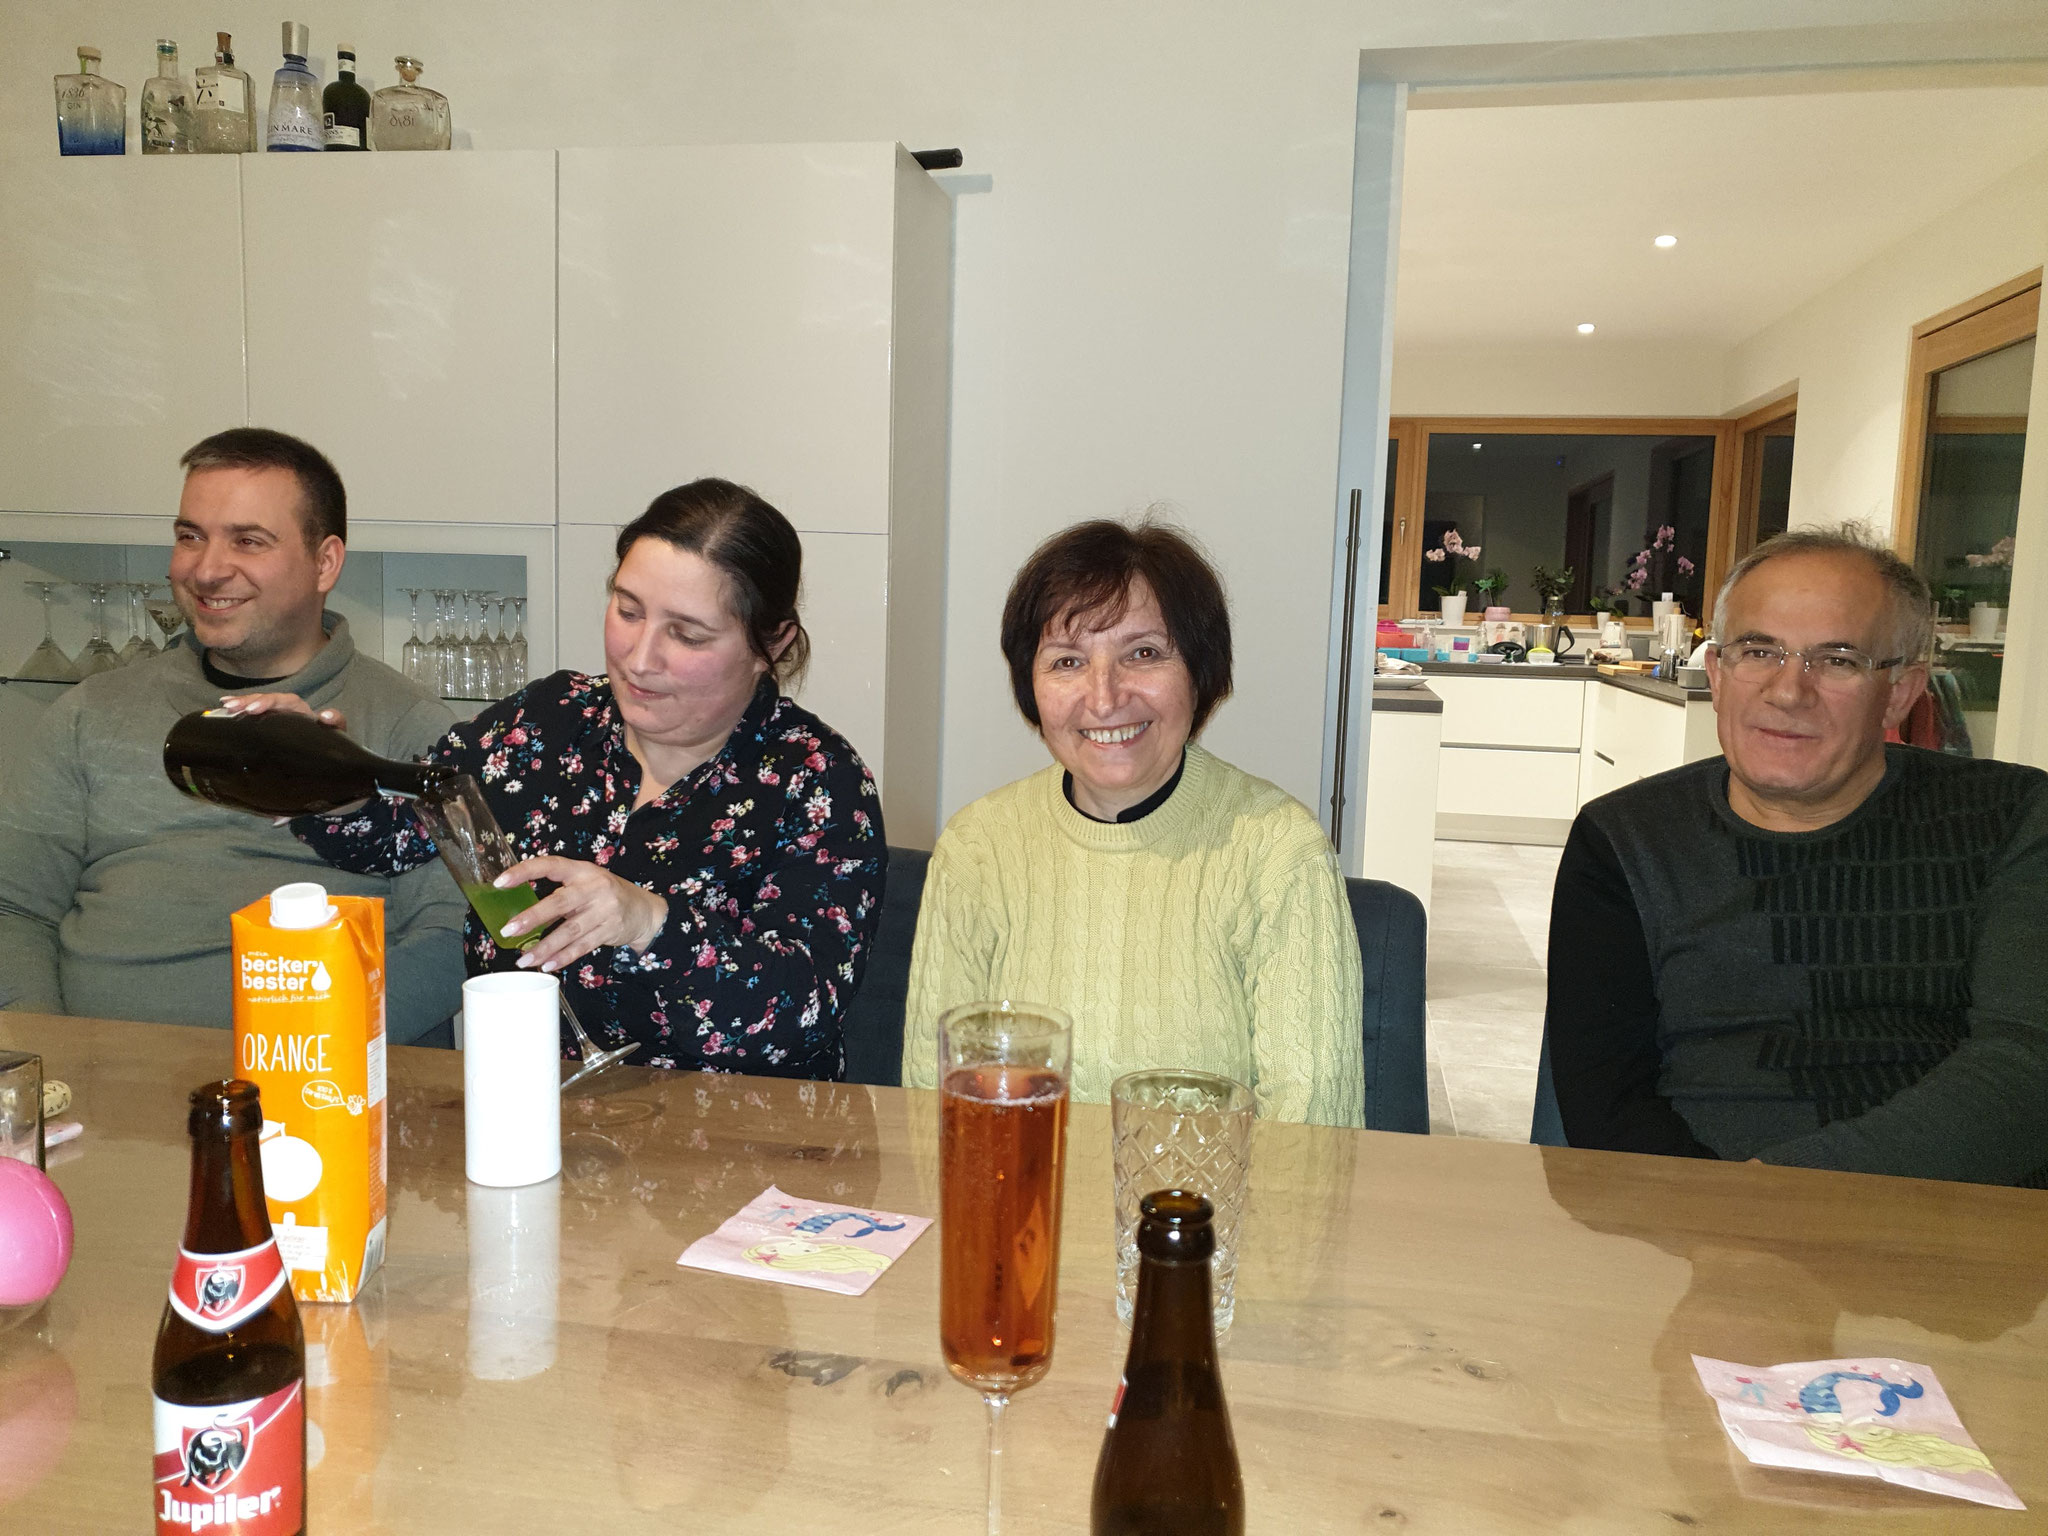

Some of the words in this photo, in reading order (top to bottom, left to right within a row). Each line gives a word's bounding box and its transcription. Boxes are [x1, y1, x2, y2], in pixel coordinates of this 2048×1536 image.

[61, 87, 85, 98] 1836
[66, 102, 81, 110] GIN
[281, 124, 313, 136] MARE
[241, 954, 318, 974] becker
[241, 971, 308, 992] bester
[242, 1033, 333, 1073] ORANGE
[158, 1486, 282, 1533] Jupiler
